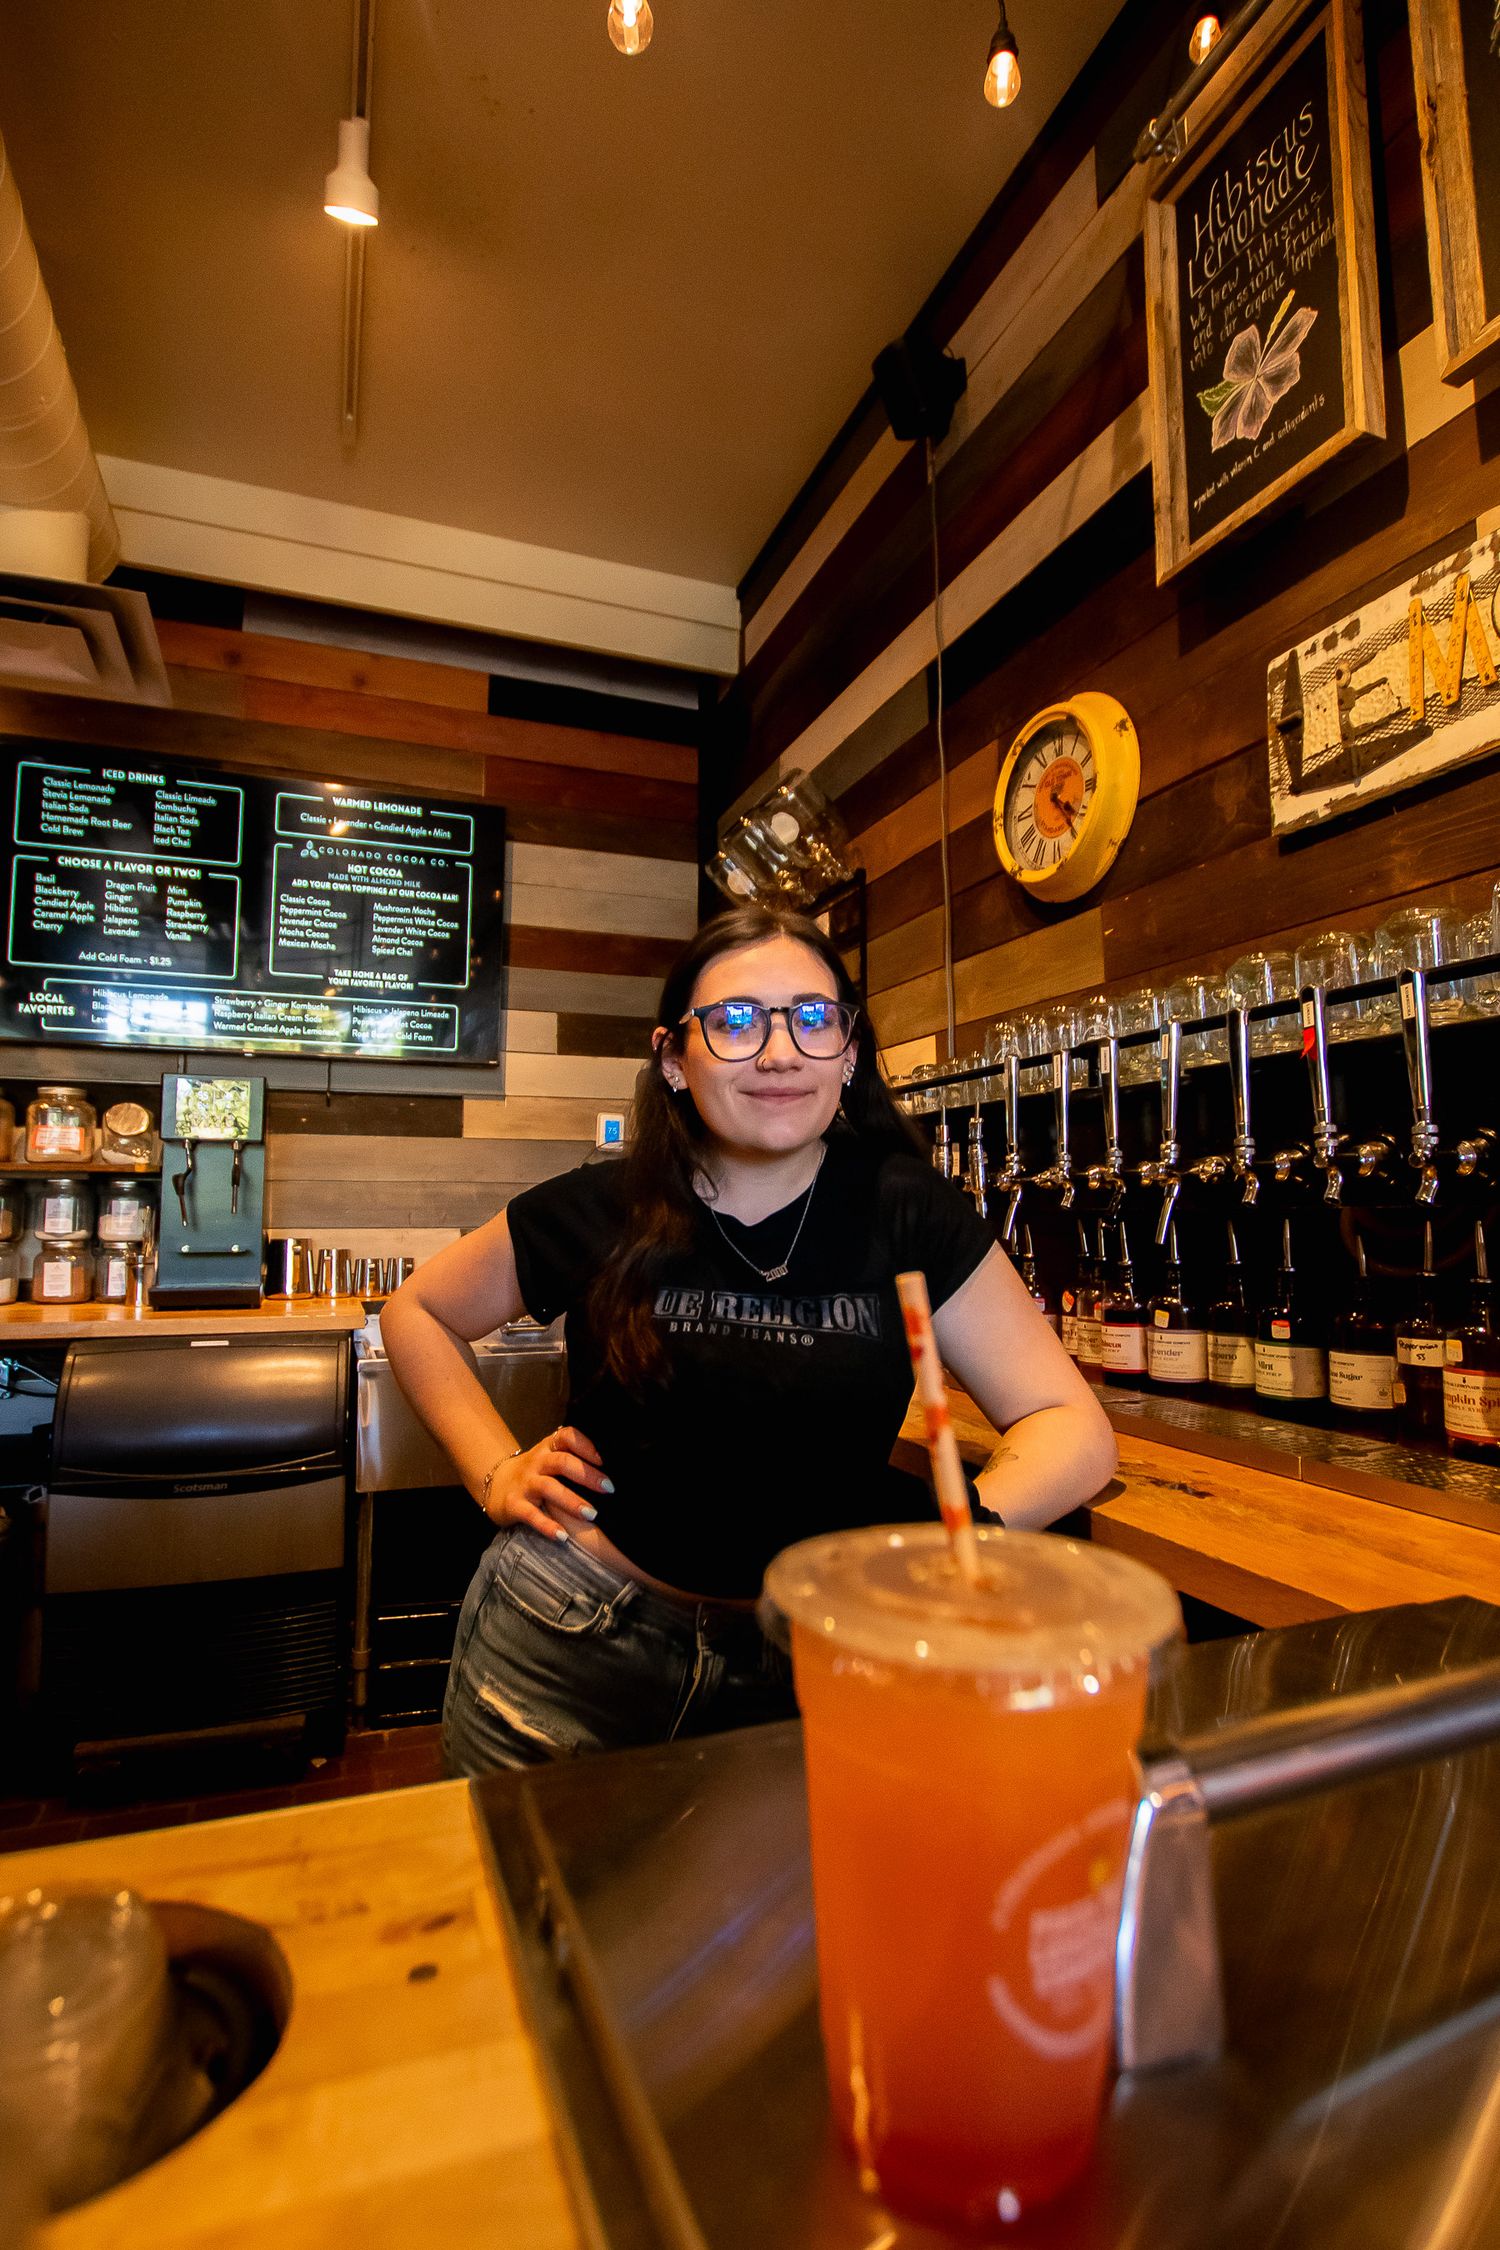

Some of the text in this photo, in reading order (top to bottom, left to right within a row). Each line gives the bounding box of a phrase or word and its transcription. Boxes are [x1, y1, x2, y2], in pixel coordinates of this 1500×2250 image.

[1194, 100, 1314, 261] Hibiscus
[1188, 142, 1320, 298] Lemonade
[1247, 190, 1324, 273] hibiscus
[1193, 208, 1324, 351] and passion fruit
[1219, 317, 1237, 343] our
[1245, 271, 1285, 320] organic
[1262, 432, 1276, 451] and
[1276, 573, 1500, 797] LEM
[102, 768, 166, 785] ICED DRINKS
[43, 776, 116, 794] Classic Lemonade
[42, 788, 111, 805] Stevia Lemonade
[155, 790, 182, 802] Classic
[42, 800, 90, 814] Italian Soda
[155, 802, 197, 815] Kombucha
[332, 797, 422, 816] WARMED LEMONADE
[41, 812, 133, 830] Homemade Root Beer
[154, 812, 200, 827] Italian Soda
[300, 812, 327, 825] Classic
[374, 821, 405, 834] Candied
[405, 824, 427, 838] Apple
[432, 828, 451, 840] Mint
[41, 824, 84, 837] Cold Brew
[154, 824, 191, 837] Black Tea
[153, 835, 191, 848] Iced Chai
[319, 846, 449, 867] COLORADO COCOA CO.
[58, 856, 201, 879] CHOOSE A FLAVOR OR TWO!
[347, 863, 403, 878] HOT COCOA
[35, 872, 56, 884] Basil
[328, 872, 421, 889] MADE WITH ALMOND MILK
[35, 885, 80, 899] Blackberry
[105, 880, 158, 893] Dragon Fruit
[167, 885, 188, 896] Mint
[292, 879, 308, 888] ADD
[310, 880, 331, 890] YOUR
[332, 882, 351, 892] OWN
[352, 883, 388, 895] TOPPINGS
[388, 887, 398, 897] AT
[399, 888, 415, 898] OUR
[416, 890, 441, 901] COCOA
[34, 897, 96, 912] Candied Apple
[105, 891, 133, 904] Ginger
[167, 896, 203, 909] Pumpkin
[280, 893, 331, 907] Classic Cocoa
[104, 903, 139, 914] Hibiscus
[166, 908, 207, 922] Raspberry
[280, 905, 348, 920] Peppermint Cocoa
[373, 902, 436, 917] Mushroom Mocha
[33, 908, 96, 924] Caramel Apple
[279, 916, 338, 930] Lavender Cocoa
[373, 913, 460, 930] Peppermint White Cocoa
[33, 920, 64, 934] Cherry
[103, 926, 140, 937] Lavender
[165, 919, 209, 934] Strawberry
[279, 927, 330, 940] Mocha Cocoa
[373, 924, 450, 940] Lavender White Cocoa
[165, 931, 192, 942] Vanilla
[372, 935, 424, 948] Almond Cocoa
[278, 938, 336, 951] Mexican Mocha
[372, 945, 413, 957] Spiced Chai
[78, 951, 96, 961] Add
[98, 952, 117, 963] Cold
[119, 953, 142, 964] Foam
[334, 968, 408, 982] TAKE HOME A BAG OF
[328, 976, 350, 987] YOUR
[350, 978, 384, 989] FAVORITE
[29, 991, 65, 1004] LOCAL
[129, 990, 169, 1001] Lemonade
[18, 1003, 76, 1016] FAVORITES
[214, 996, 329, 1012] Strawberry Ginger Kombucha
[352, 1004, 382, 1014] Hibiscus
[214, 1008, 322, 1024] Raspberry Italian Cream Soda
[213, 1021, 245, 1031] Warmed
[247, 1022, 277, 1033] Candied
[278, 1024, 301, 1036] Apple
[410, 1020, 432, 1030] Cocoa
[414, 1032, 433, 1041] Foam
[607, 1126, 617, 1135] 75
[653, 1289, 880, 1337] UE RELIGION
[669, 1321, 730, 1336] BRAND
[173, 1482, 228, 1493] Scotsman
